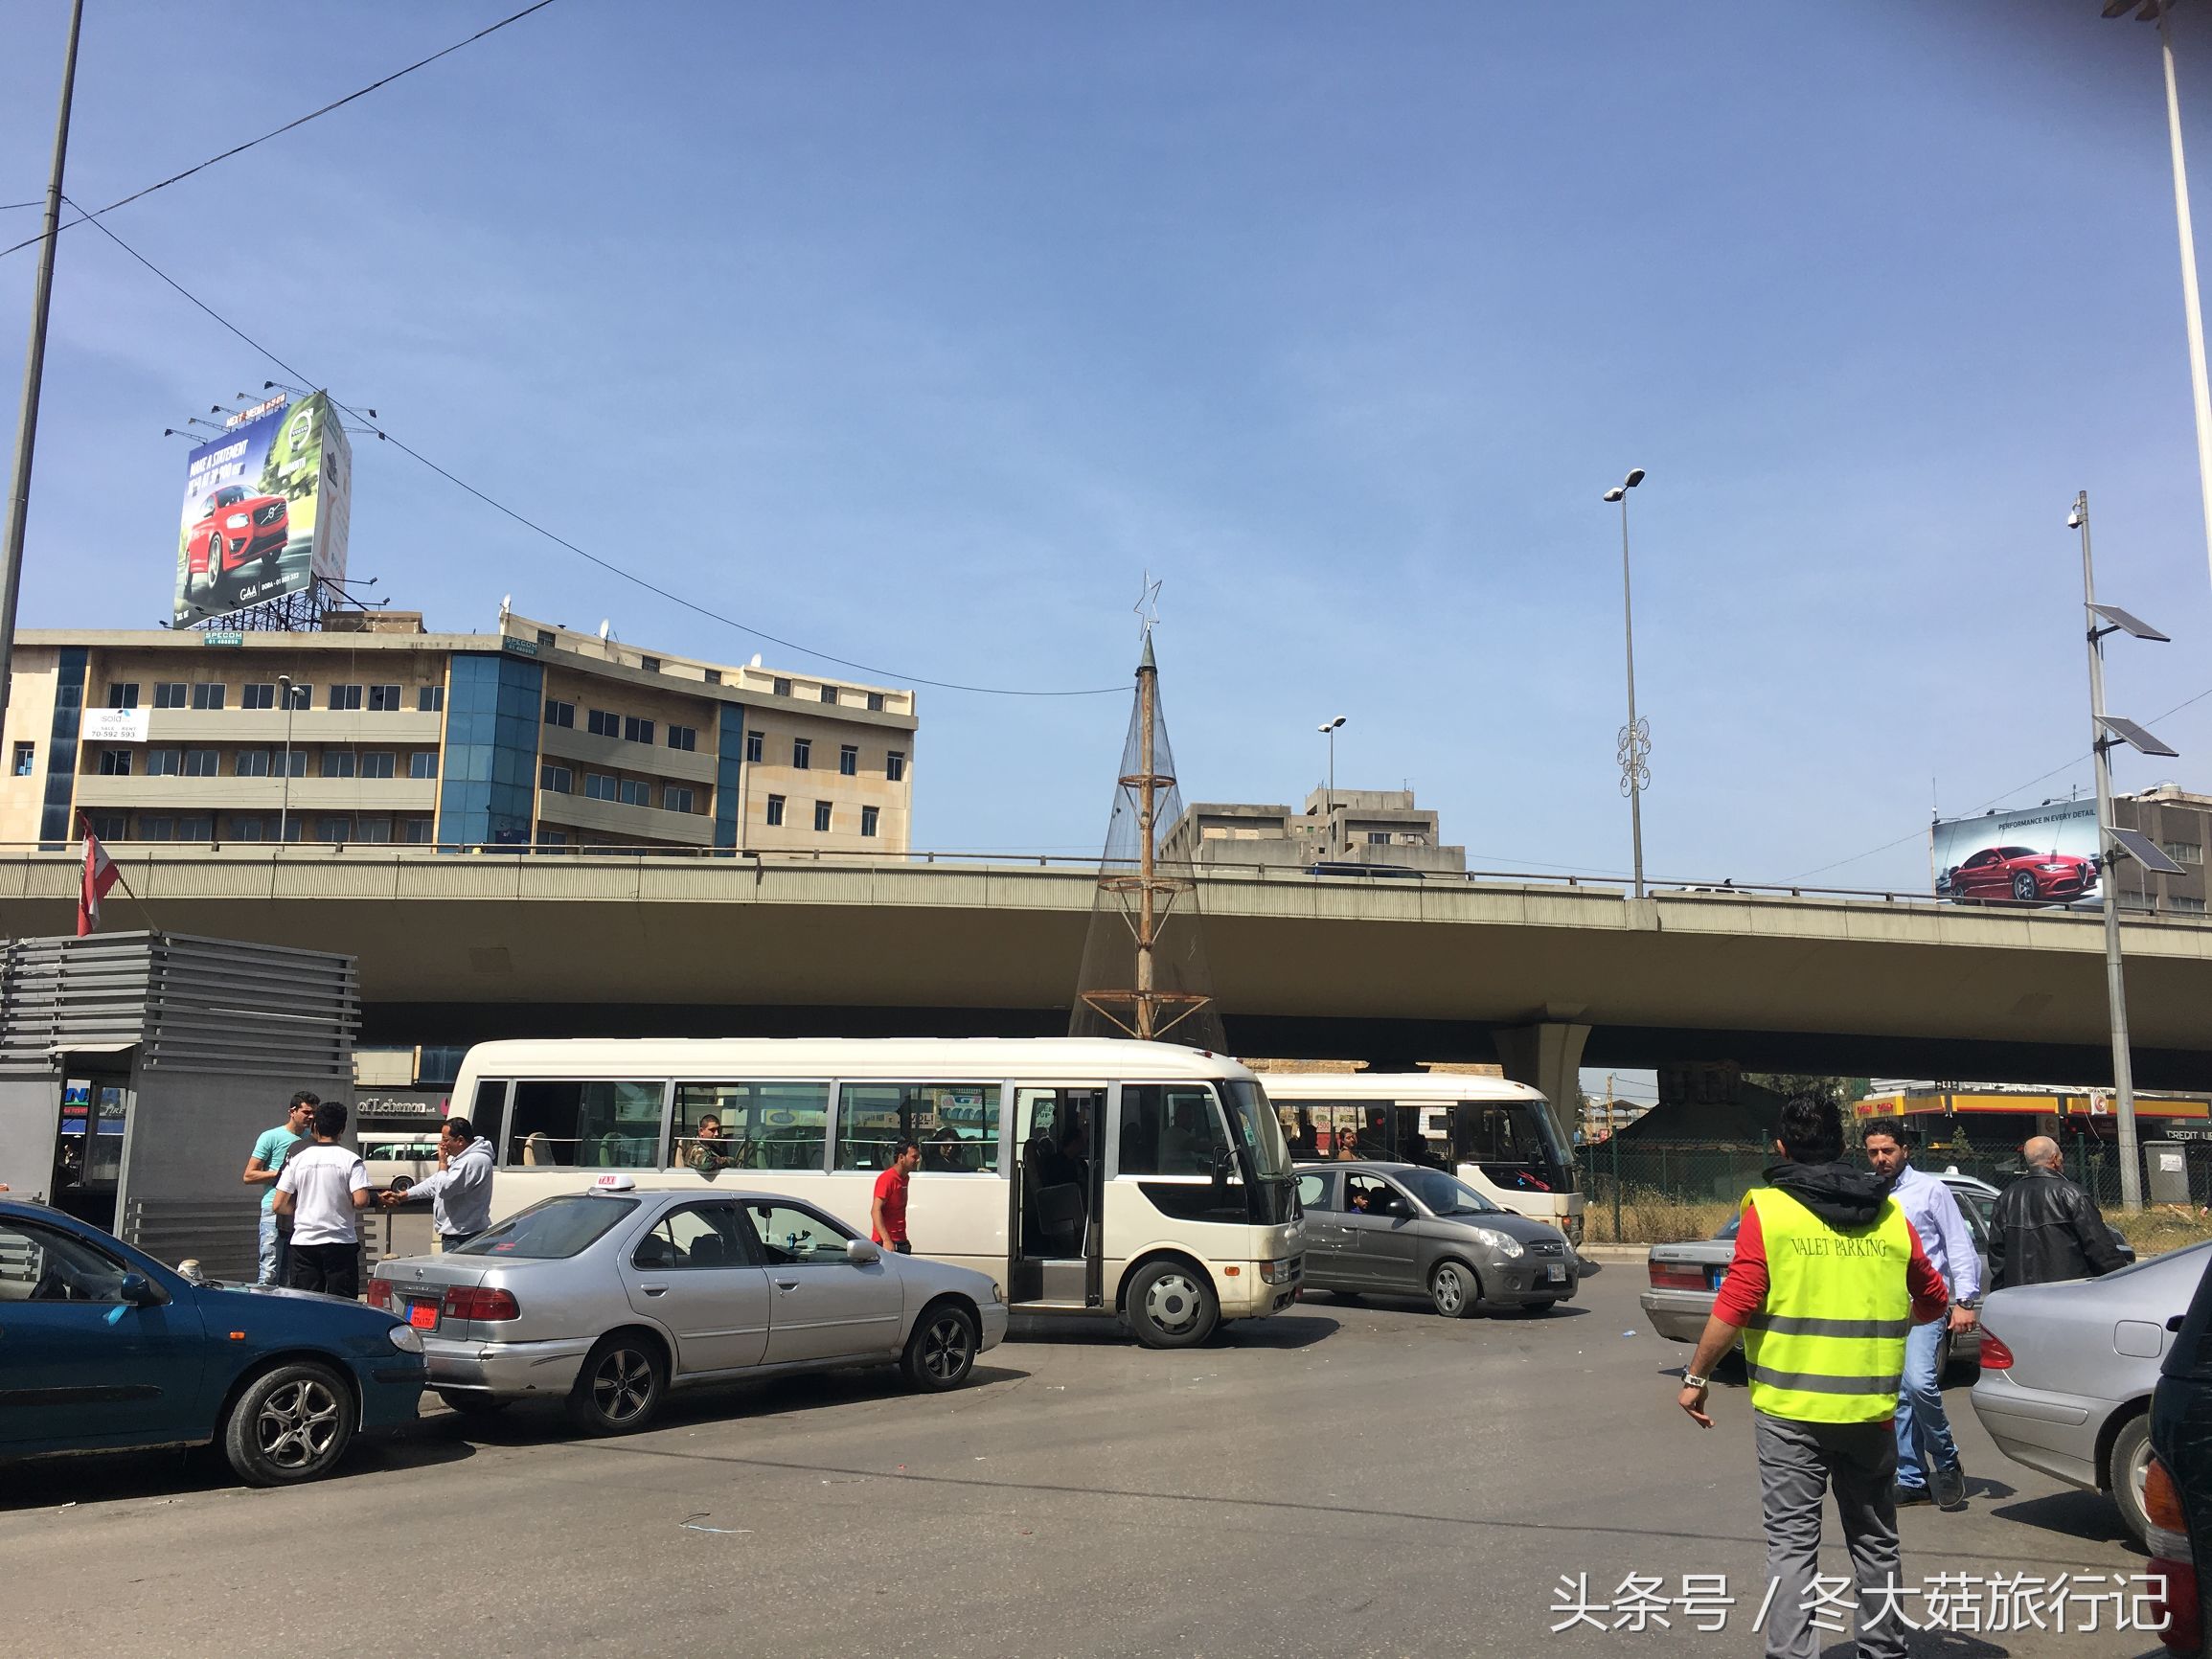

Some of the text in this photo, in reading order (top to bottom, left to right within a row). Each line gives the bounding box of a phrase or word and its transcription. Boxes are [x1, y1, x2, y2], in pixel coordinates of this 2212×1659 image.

[190, 456, 208, 477] MAKE
[212, 439, 249, 467] STATEMENT
[1998, 817, 2042, 830] PERFORMANCE
[2050, 812, 2071, 822] EVERY
[2072, 809, 2096, 819] DETAIL
[372, 1098, 426, 1113] Lebanon
[2166, 1130, 2198, 1140] CREDIT
[598, 1175, 617, 1185] TAXI
[1790, 1238, 1886, 1257] VALET PARKING
